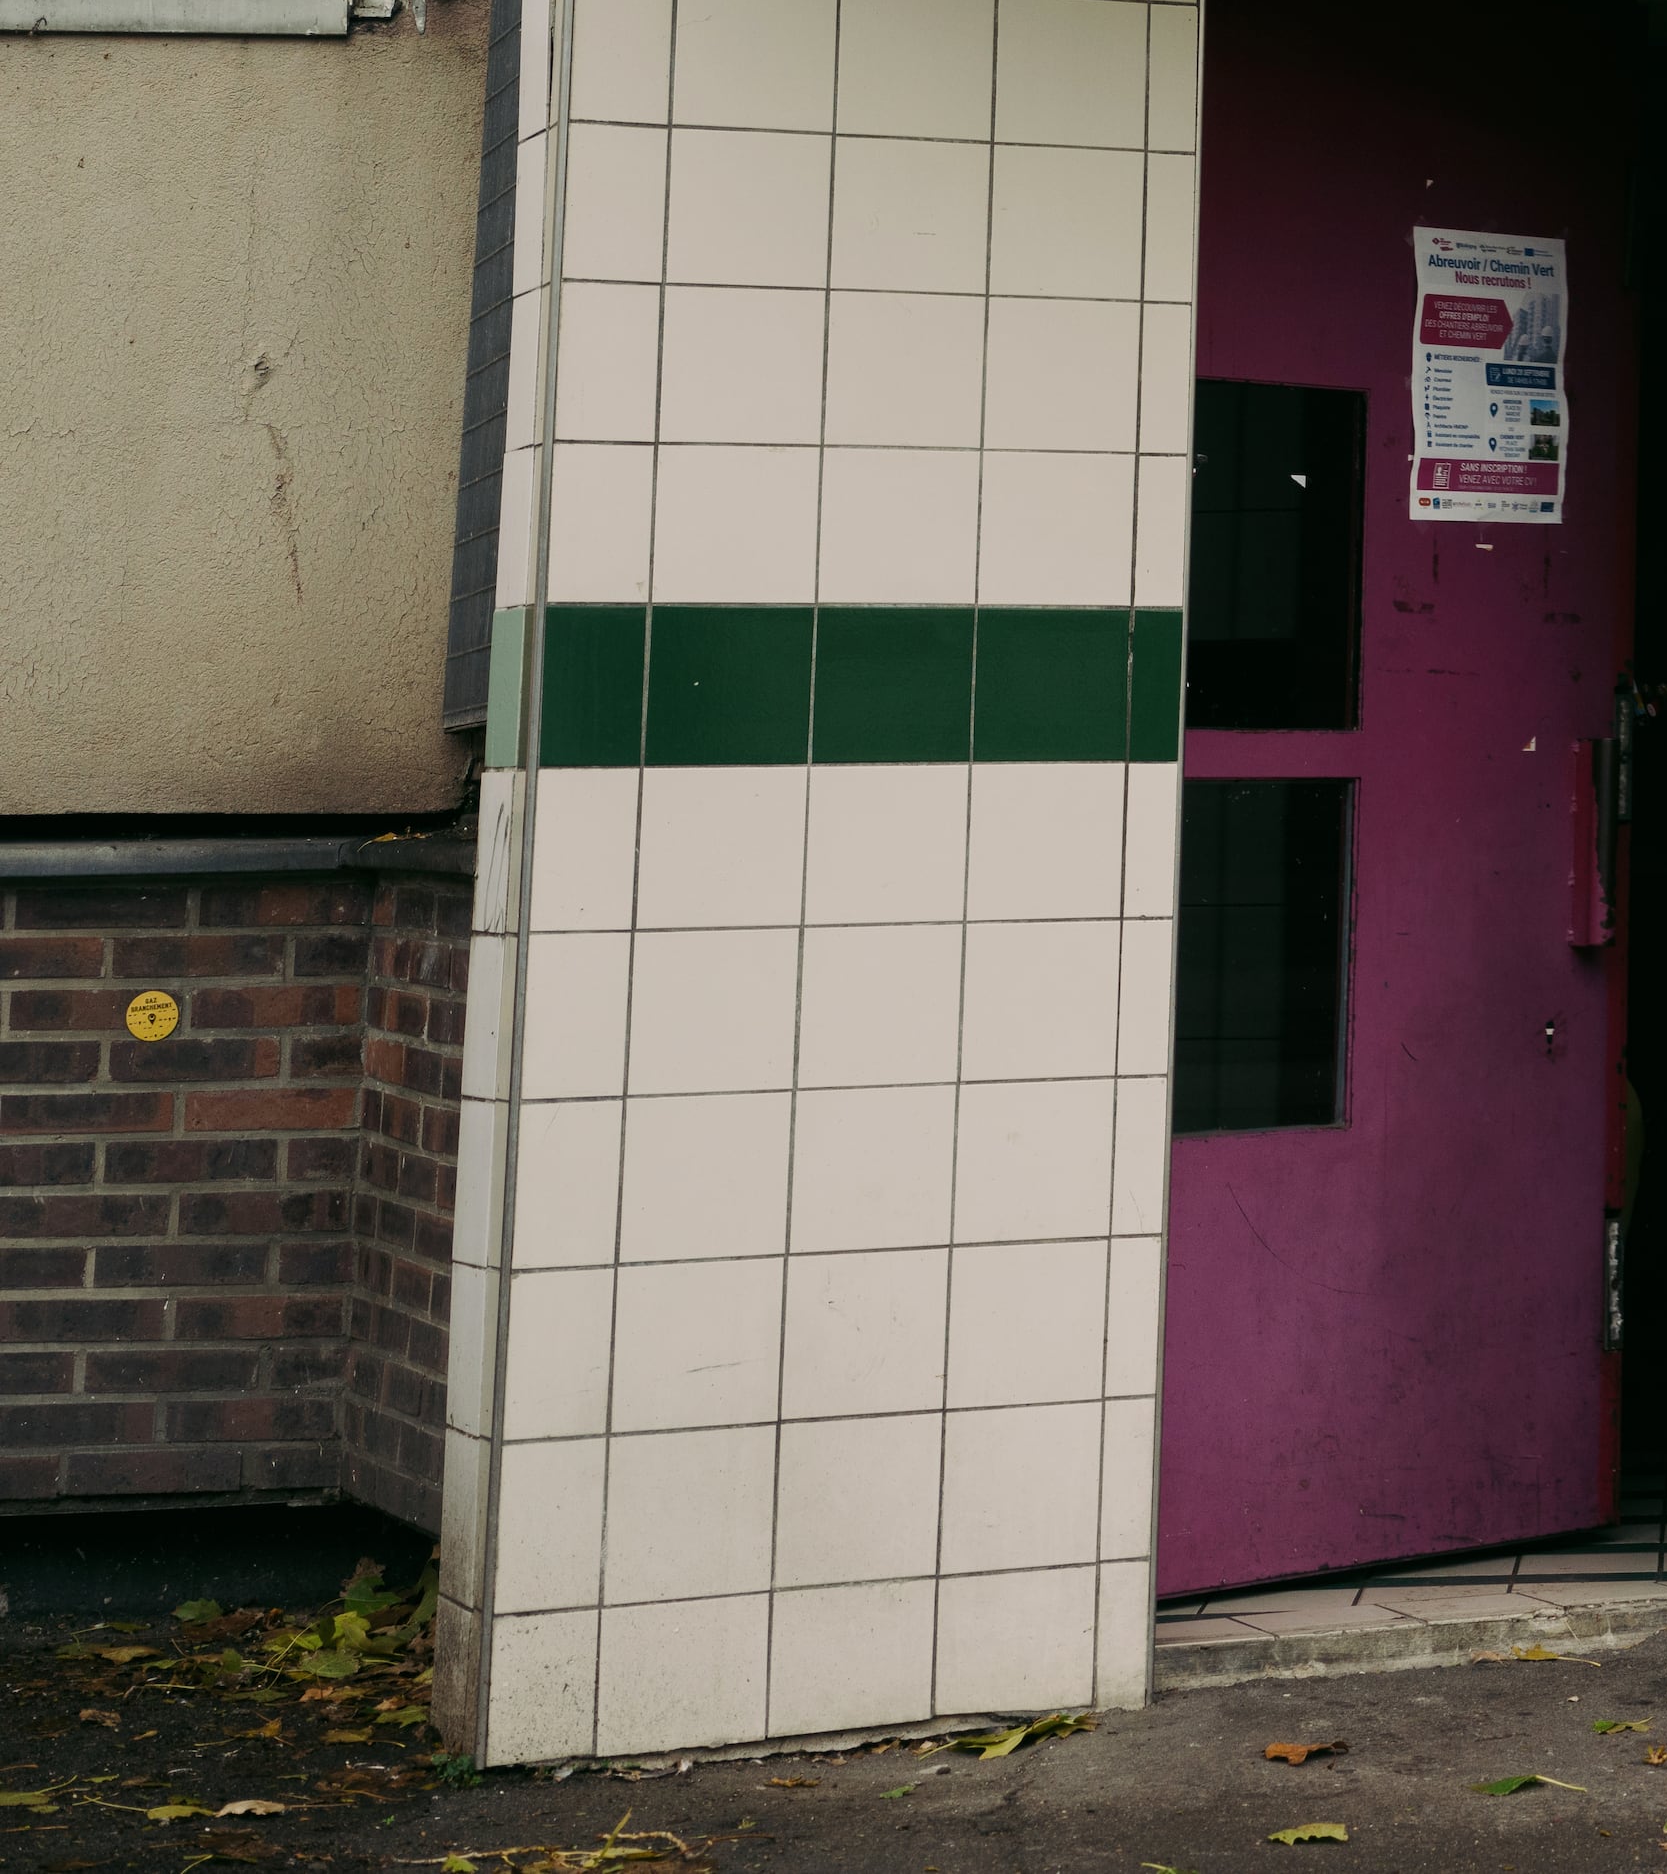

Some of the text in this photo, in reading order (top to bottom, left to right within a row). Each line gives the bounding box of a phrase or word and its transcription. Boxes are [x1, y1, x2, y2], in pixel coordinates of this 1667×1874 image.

[1428, 254, 1481, 270] Abreuvoir
[1490, 260, 1530, 275] Chemin
[1532, 264, 1555, 277] Vert
[1455, 271, 1479, 285] Nous
[1481, 274, 1526, 289] recrutons
[1434, 301, 1454, 310] VENEZ
[1439, 311, 1462, 320] OFFRES
[1424, 319, 1504, 332] DES CHANTIERS ABREUVOIR
[1439, 329, 1487, 341] ET CHEMIN VERT
[1460, 462, 1480, 472] SANS
[1480, 464, 1523, 474] INSCRIPTION
[1459, 474, 1482, 484] VENEZ
[1482, 475, 1500, 485] AVEC
[1501, 476, 1523, 485] VOTRE
[1524, 477, 1533, 486] CV
[131, 1002, 172, 1013] BRANCHEMENT
